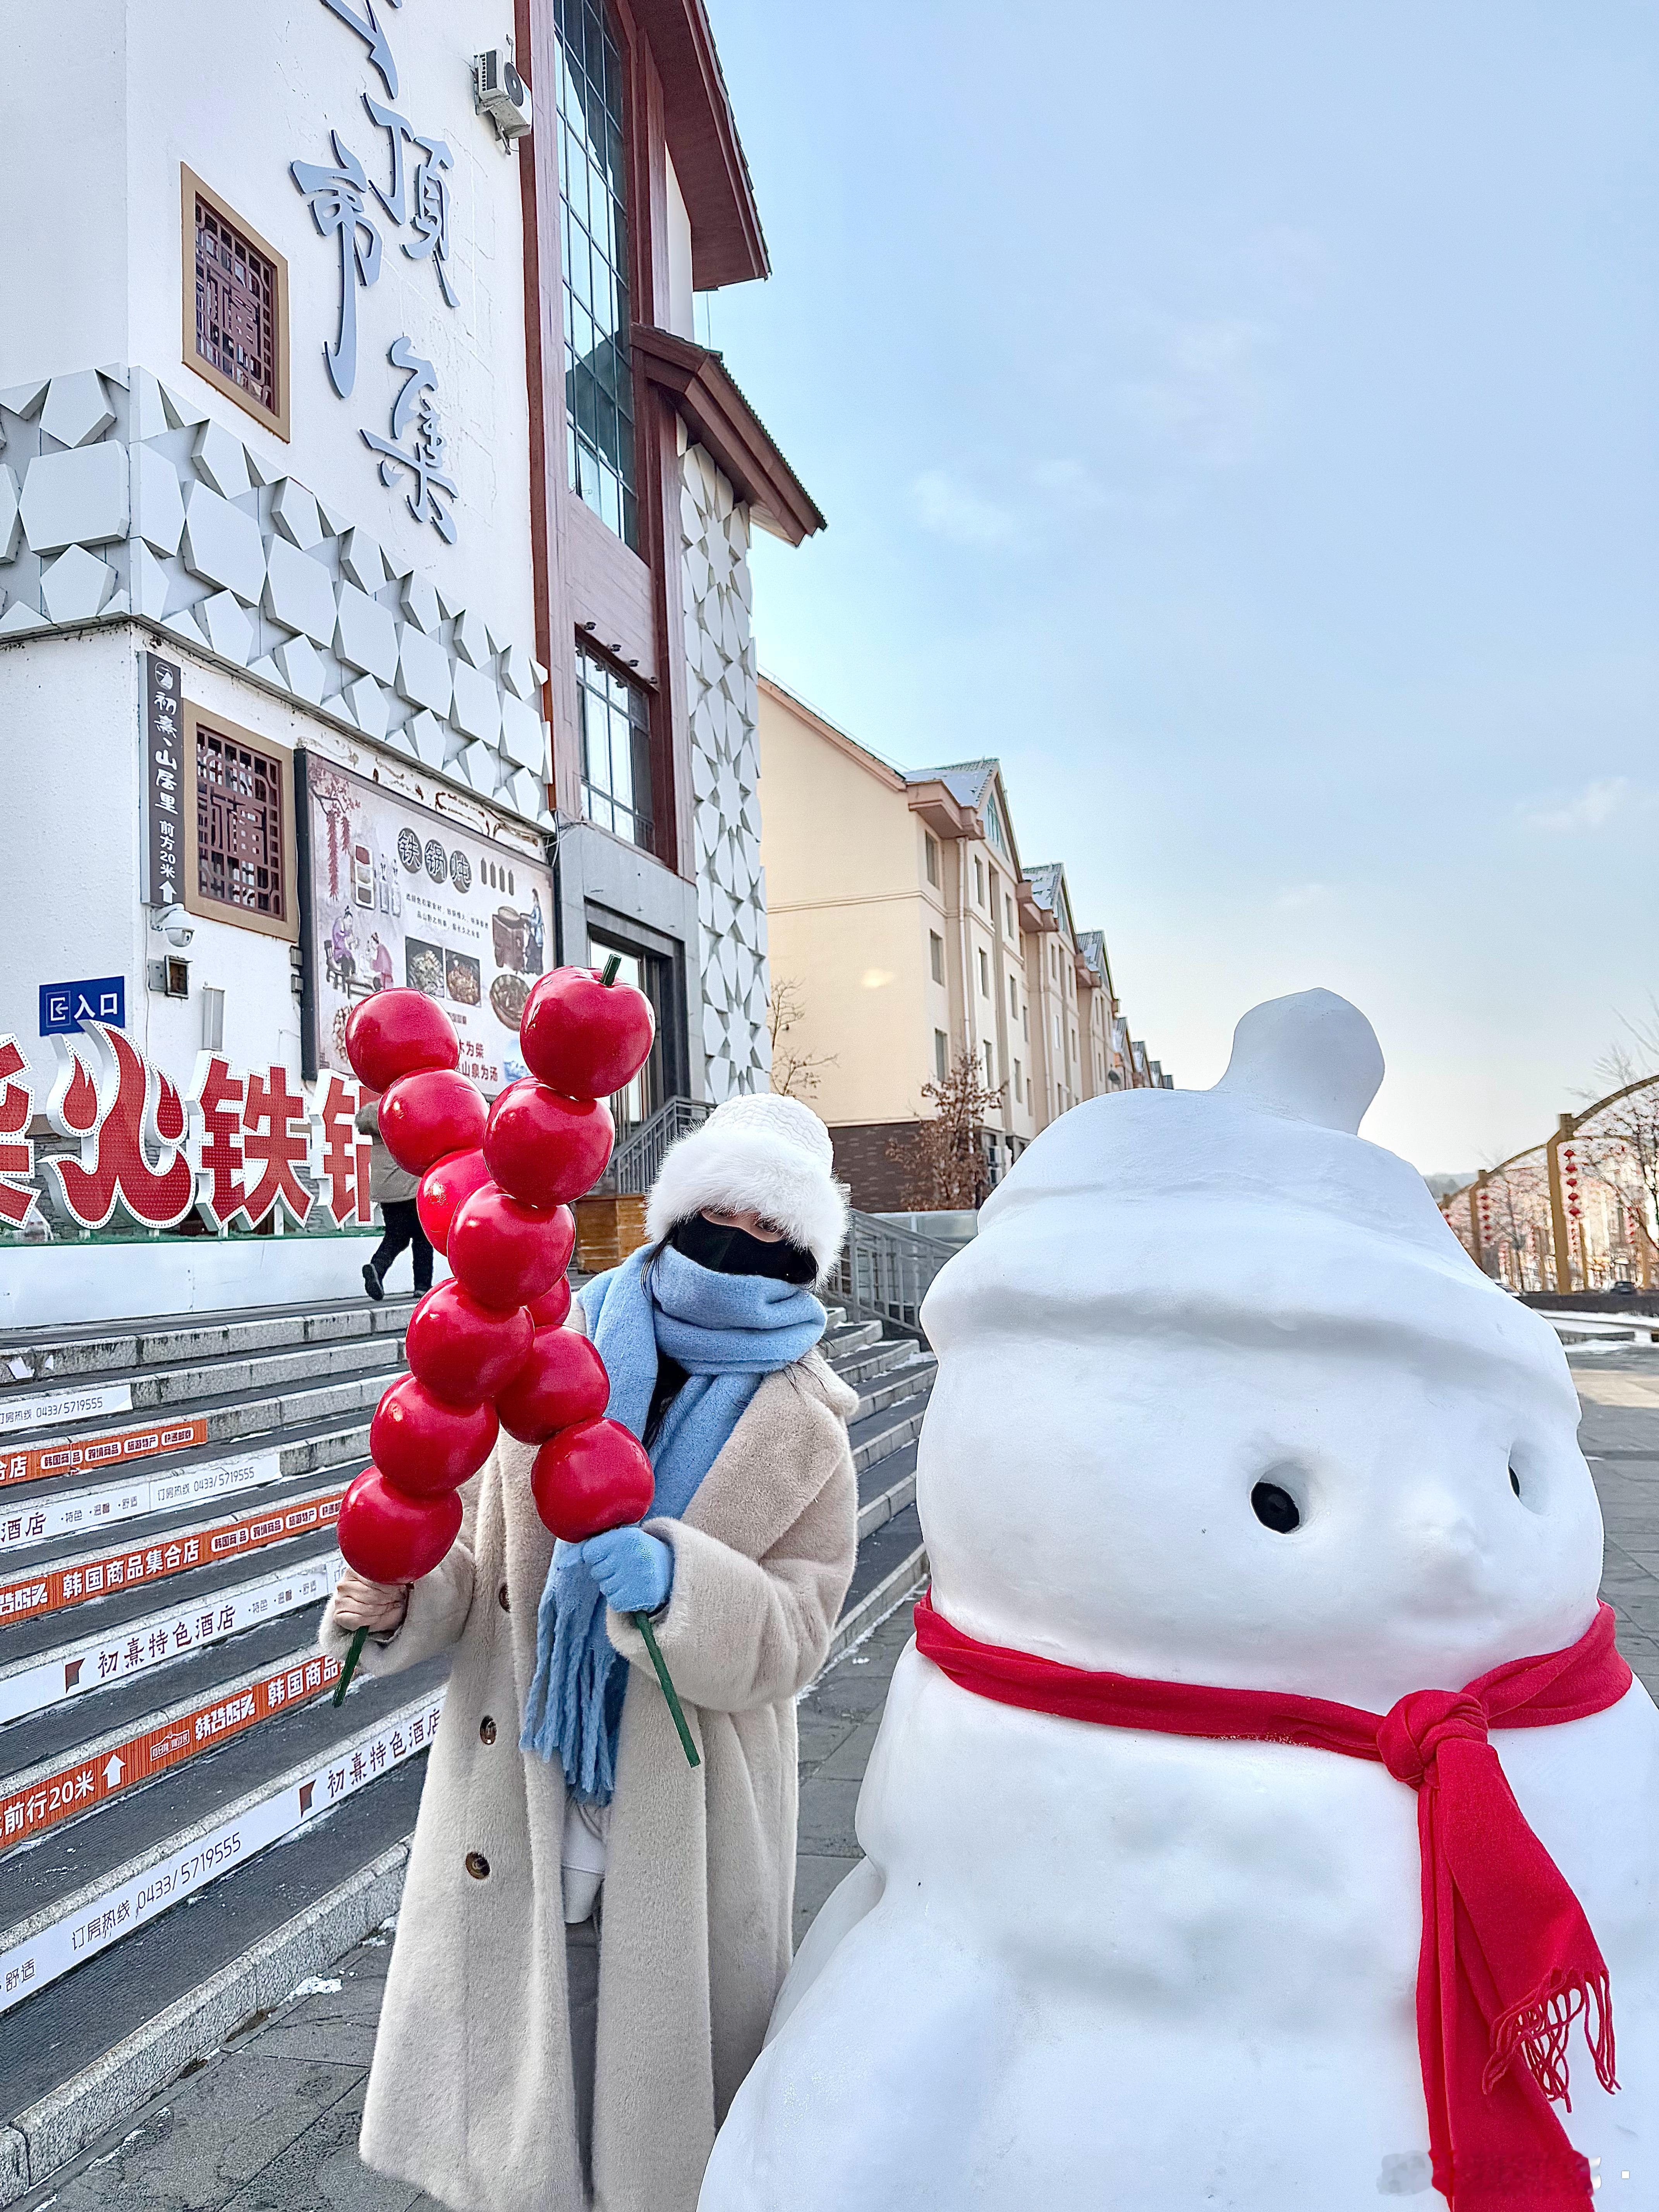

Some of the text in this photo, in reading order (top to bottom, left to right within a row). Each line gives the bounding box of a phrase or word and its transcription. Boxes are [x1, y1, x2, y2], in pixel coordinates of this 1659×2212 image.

[159, 820, 175, 878] 前方20米
[398, 830, 471, 890] 铁锅炖
[74, 994, 118, 1020] 入口
[36, 1397, 103, 1417] 0433/5719555
[45, 1452, 81, 1467] 韩国商品
[0, 1512, 47, 1542] 酒店
[157, 1484, 189, 1501] 订房热线
[194, 1467, 254, 1492] 0433/5719555
[62, 1539, 200, 1599] 韩国商品集合店
[215, 1530, 246, 1549] 韩国商品
[0, 1770, 94, 1837] 前行20米
[268, 1656, 345, 1707] 韩国商品
[72, 1899, 131, 1951] 订房热线
[137, 1832, 241, 1910] 0433/5719555
